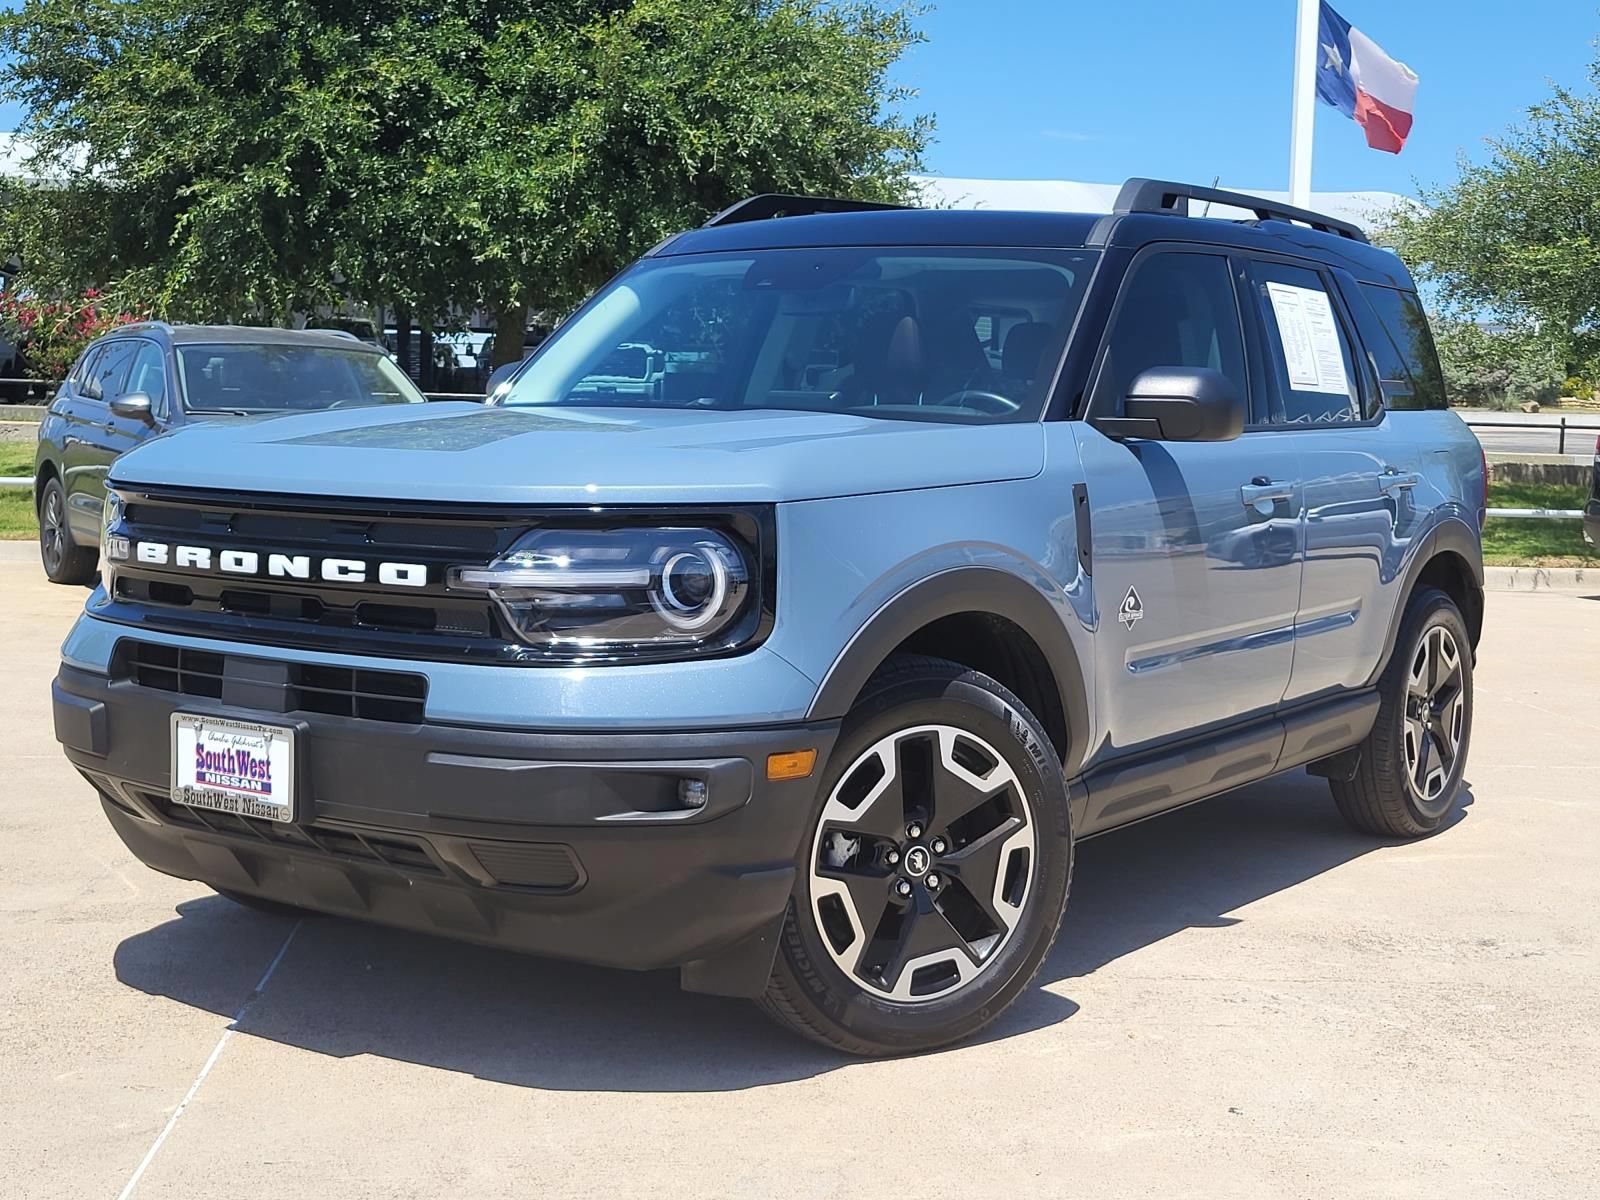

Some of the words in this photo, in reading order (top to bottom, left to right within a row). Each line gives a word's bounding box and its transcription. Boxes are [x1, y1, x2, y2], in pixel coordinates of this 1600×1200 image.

[136, 541, 427, 587] BRONCO
[196, 743, 272, 780] SouthWest
[204, 772, 262, 790] NISSAN
[183, 788, 239, 813] SouthWest
[243, 797, 280, 820] Nissan
